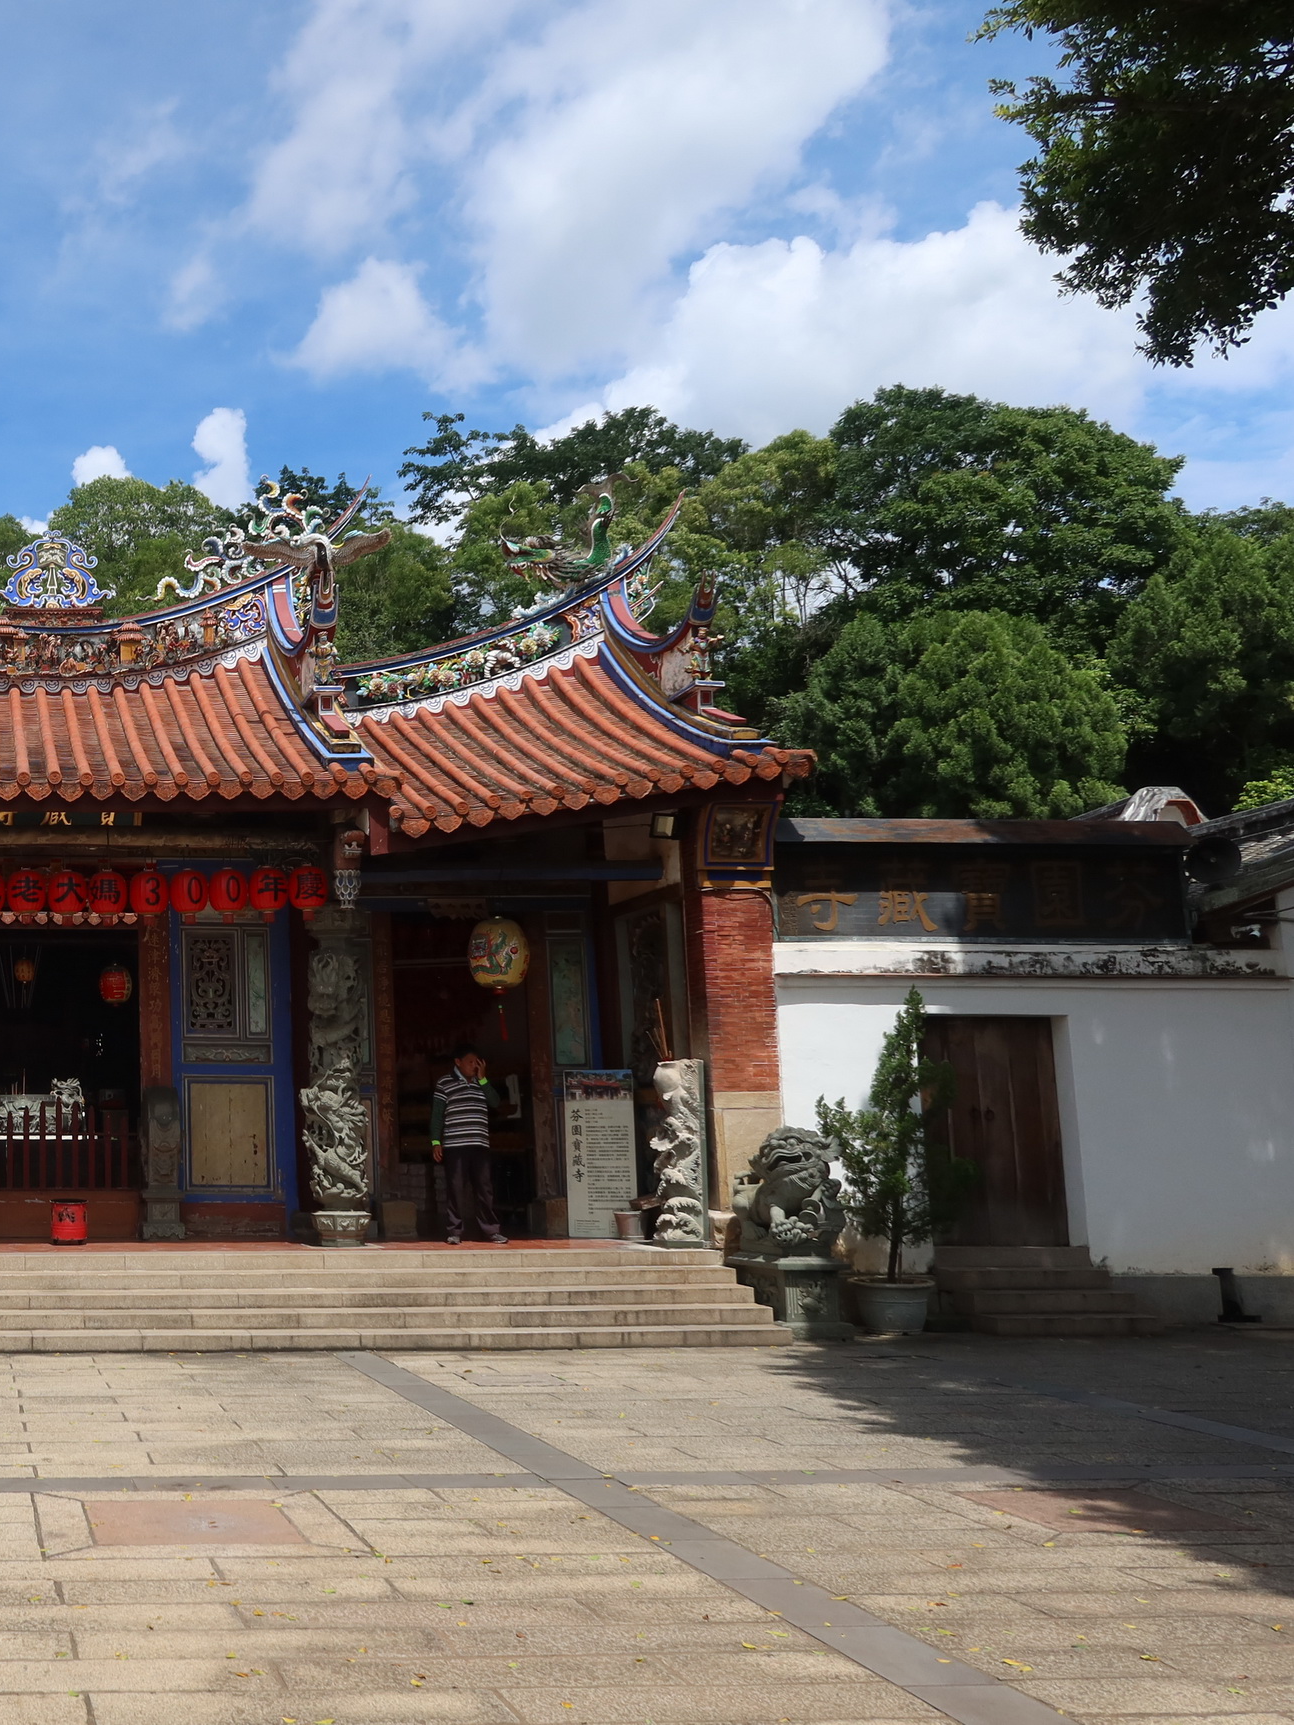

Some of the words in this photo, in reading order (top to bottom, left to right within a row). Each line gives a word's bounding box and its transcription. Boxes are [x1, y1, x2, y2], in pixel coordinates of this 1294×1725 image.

[570, 1109, 585, 1183] 芬園寶藏寺
